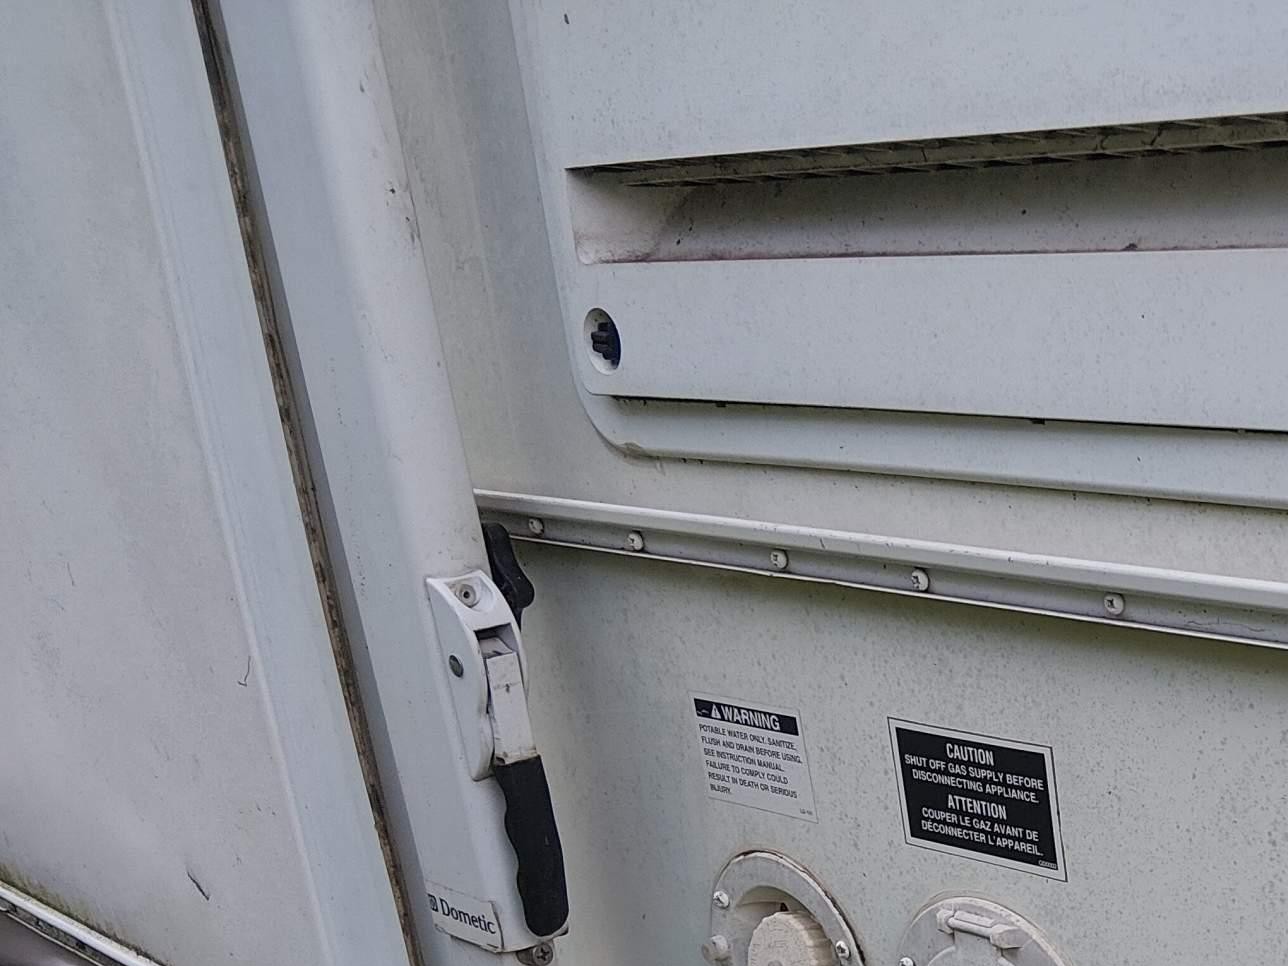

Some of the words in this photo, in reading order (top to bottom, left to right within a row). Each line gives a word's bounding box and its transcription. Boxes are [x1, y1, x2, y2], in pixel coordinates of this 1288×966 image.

[721, 705, 780, 730] WARNING
[699, 724, 726, 736] POTABLE
[728, 730, 748, 740] WATER
[701, 736, 721, 747] FLUSH
[722, 740, 735, 749] AND
[736, 743, 755, 754] DRAIN
[756, 748, 781, 759] BEFORE
[704, 748, 715, 756] SEE
[717, 751, 756, 766] INSTRUCTION
[946, 743, 994, 766] CAUTION
[706, 760, 730, 772] FAILURE
[732, 765, 740, 773] TO
[741, 767, 766, 778] COMPLY
[767, 774, 788, 784] COULD
[708, 772, 730, 782] RESULT
[732, 777, 738, 785] IN
[740, 778, 759, 789] DEATH
[760, 783, 770, 792] OR
[771, 786, 797, 798] SERIOUS
[904, 754, 927, 766] SHUT
[929, 760, 946, 770] OFF
[948, 763, 967, 775] GAS
[968, 767, 1004, 783] SUPPLY
[1006, 773, 1045, 790] BEFORE
[912, 769, 984, 792] DISCONNECTING
[985, 784, 1039, 804] APPLIANCE.
[948, 794, 1007, 820] ATTENTION
[921, 808, 958, 824] COUPER
[960, 816, 971, 826] LE
[973, 818, 992, 830] GAZ
[994, 824, 1024, 839] AVANT
[1026, 830, 1039, 842] DE
[921, 819, 987, 843] DÉCONNECTER
[988, 833, 1044, 856] L'APPAREIL.
[439, 897, 496, 934] Dometic
